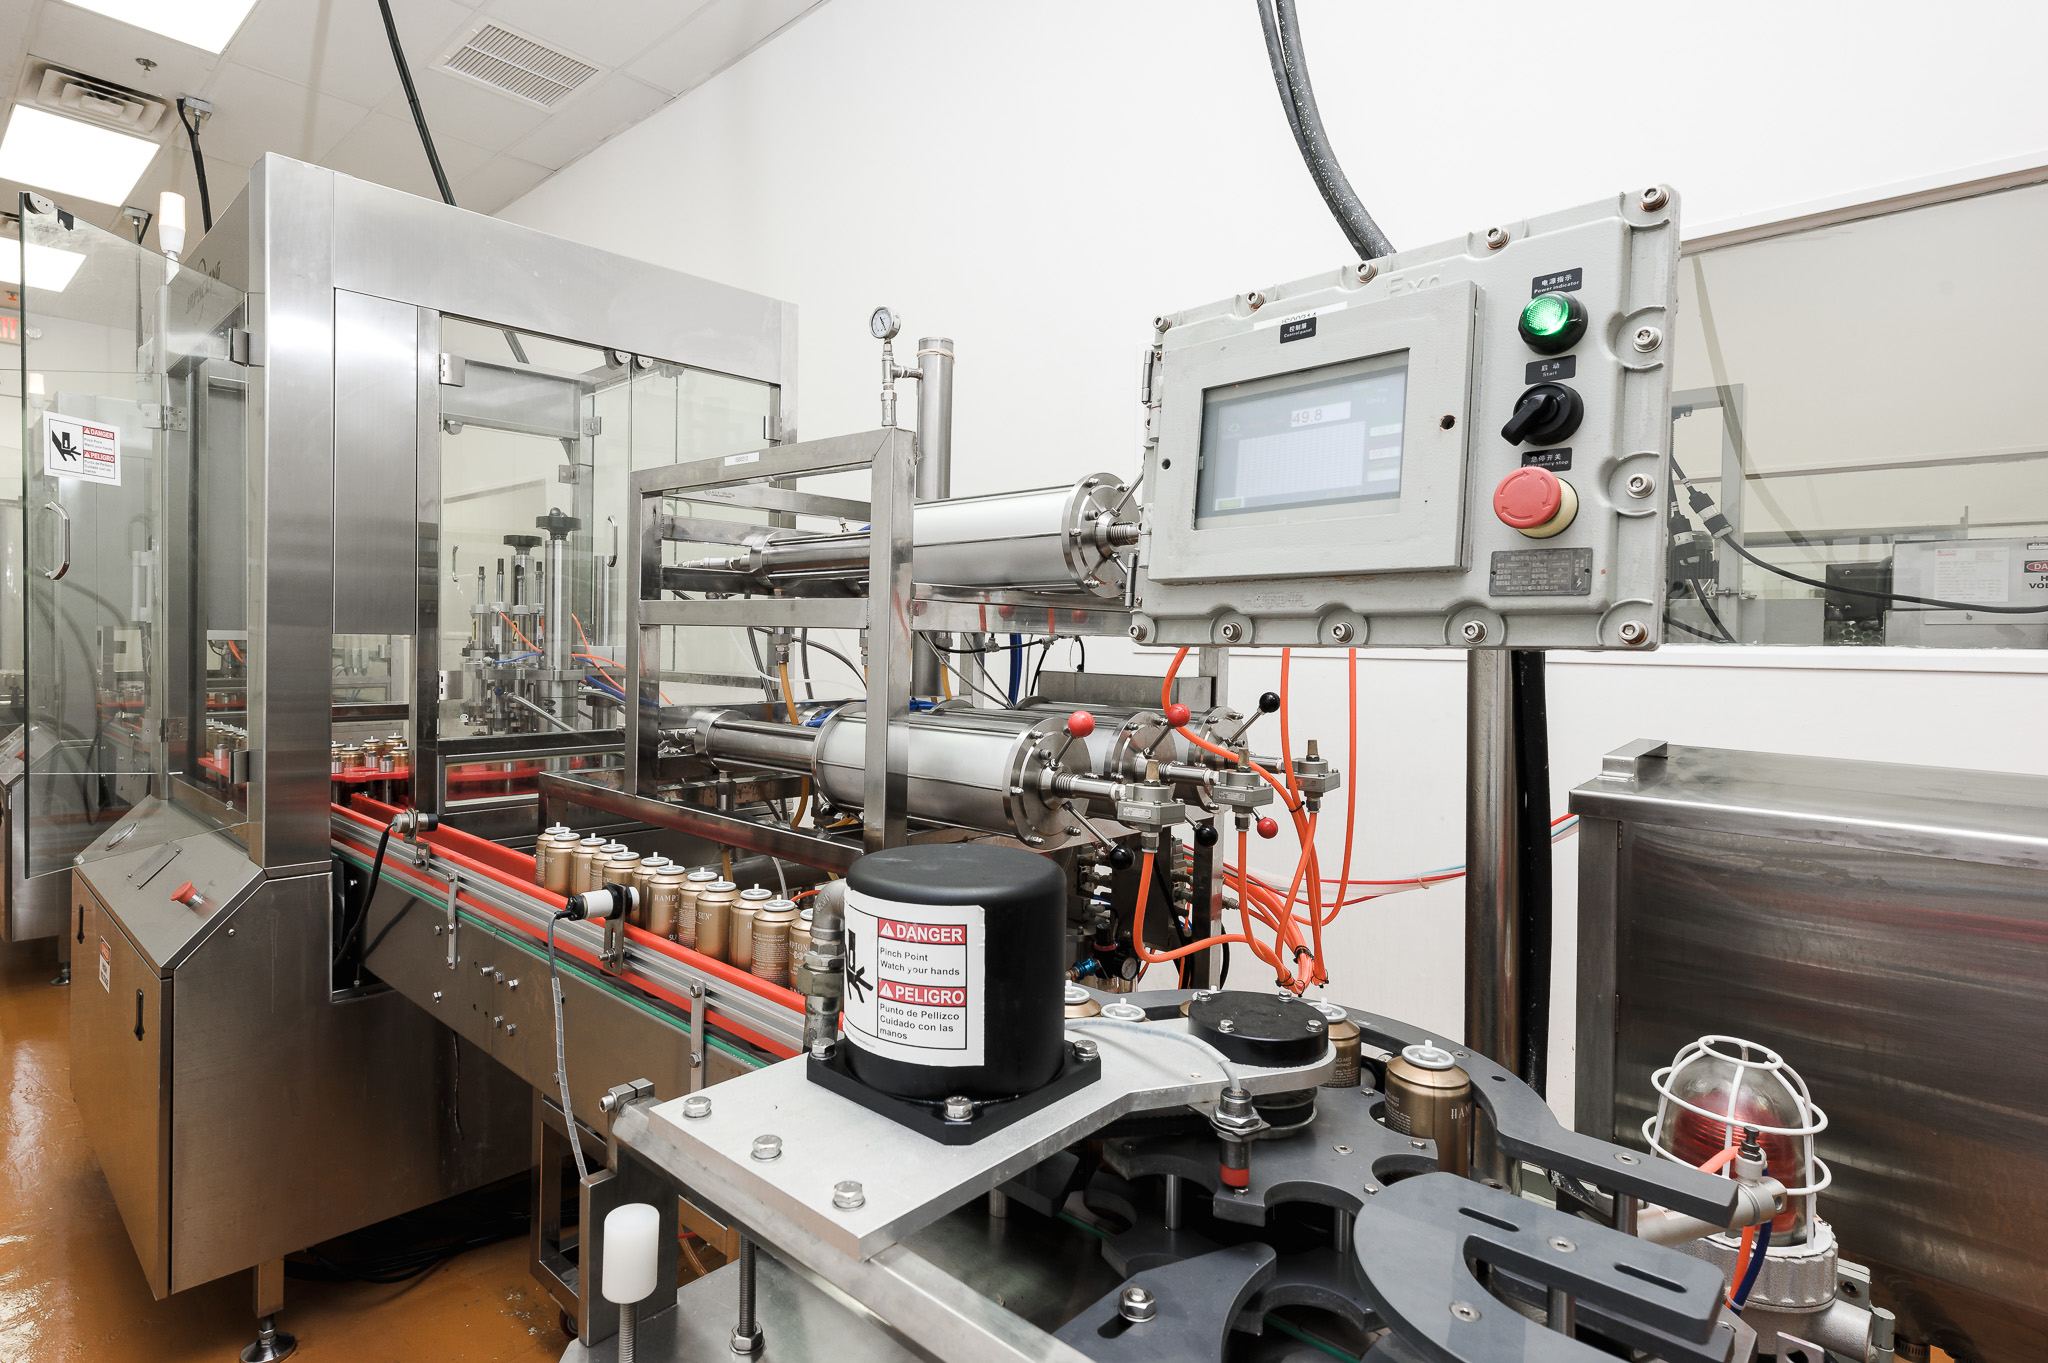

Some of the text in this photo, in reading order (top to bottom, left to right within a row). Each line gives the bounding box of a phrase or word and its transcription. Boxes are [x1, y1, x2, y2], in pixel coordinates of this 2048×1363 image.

[1541, 273, 1573, 287] 电源指示
[1534, 280, 1580, 295] Power indicator
[1283, 329, 1301, 338] Control
[1291, 408, 1323, 424] 49.8
[90, 427, 114, 439] DANGER
[90, 451, 115, 462] PELIGRO
[1530, 453, 1562, 463] 急停开关
[896, 924, 963, 942] DANGER
[880, 947, 928, 961] Pinch Point
[880, 959, 960, 976] Watch your hands
[895, 985, 965, 1004] PELIGRO
[880, 1003, 960, 1020] Punto de Pellizco
[880, 1015, 954, 1032] Cuidado con las
[880, 1028, 908, 1040] manos
